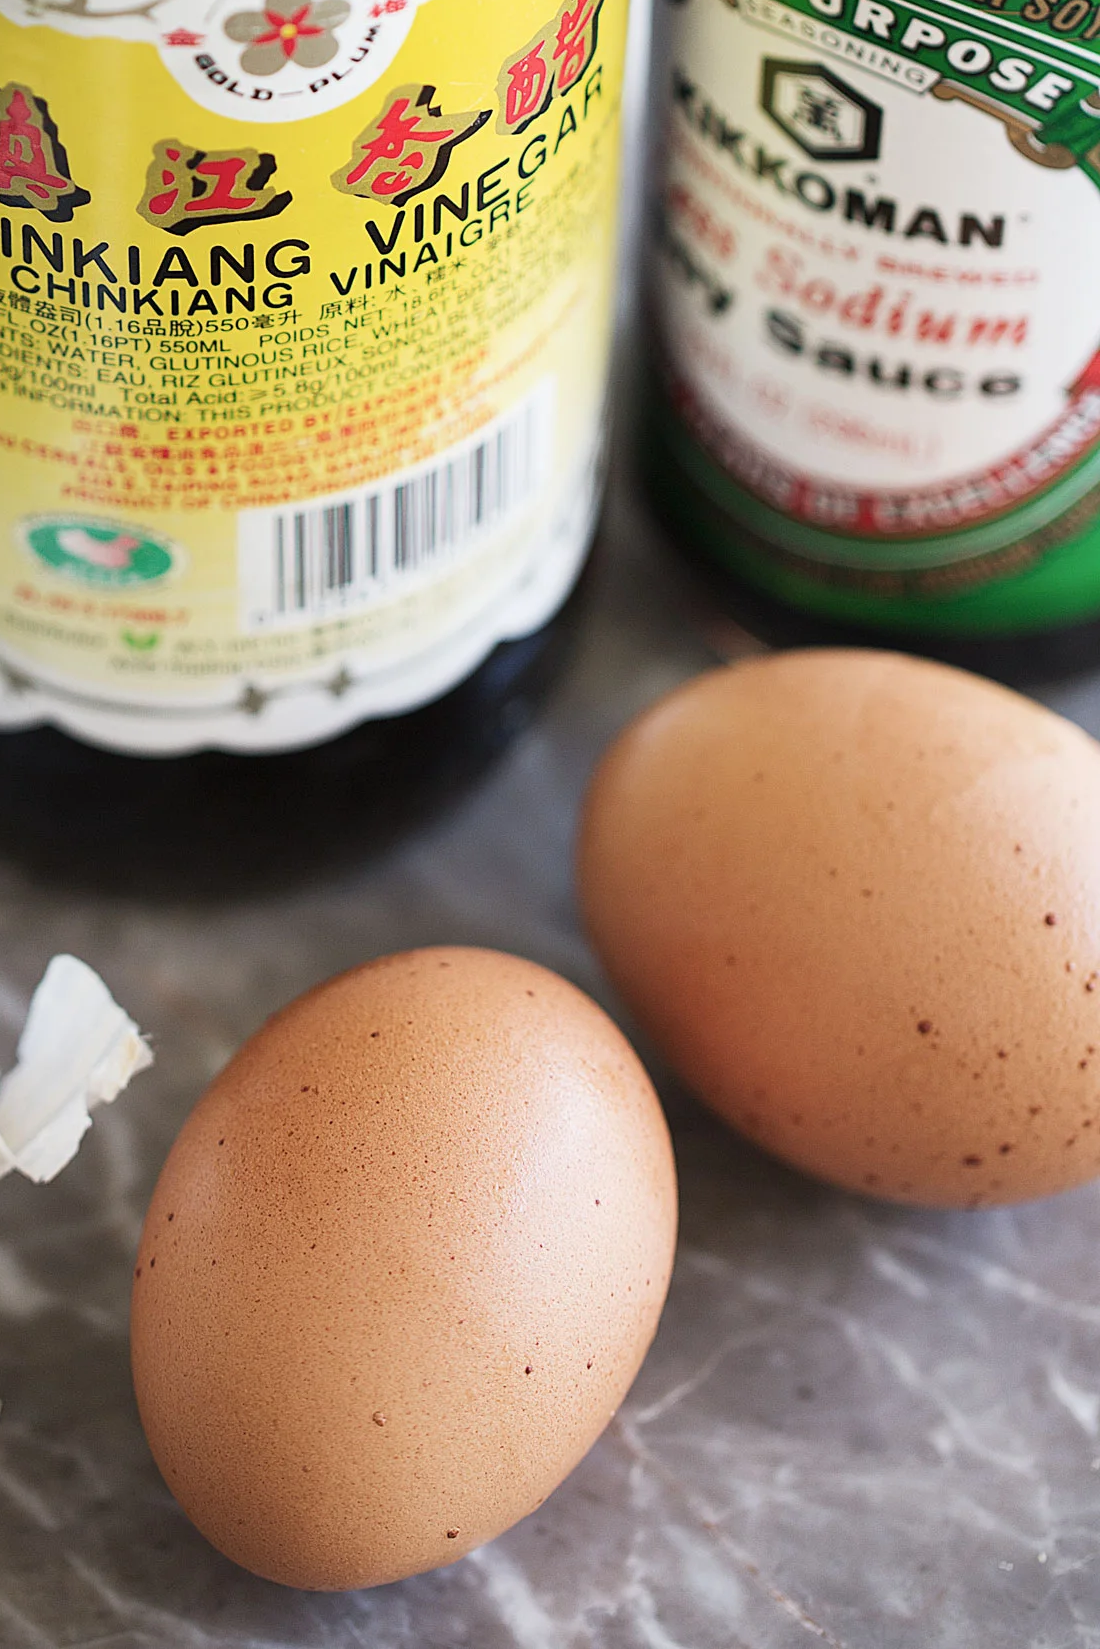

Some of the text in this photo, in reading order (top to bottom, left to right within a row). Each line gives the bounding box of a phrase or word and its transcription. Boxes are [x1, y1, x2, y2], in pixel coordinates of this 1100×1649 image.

[194, 23, 381, 101] GOLD PLUM
[365, 64, 603, 256] VINEGAR
[10, 264, 294, 317] CHINKIANG
[330, 178, 535, 296] VINAIGRE
[755, 242, 1030, 347] Sodium
[48, 341, 142, 371] WATER,
[149, 347, 294, 371] GLUTINOUS
[303, 332, 365, 359] RICE,
[372, 299, 447, 340] WHEAT
[97, 367, 153, 389] EAU,
[161, 373, 201, 389] RIZ
[208, 353, 355, 388] GLUTINEUX,
[159, 338, 232, 354] 550ML
[259, 324, 330, 348] POIDS
[763, 306, 1022, 398] Sauce
[13, 382, 188, 423] INFORMATION:
[196, 405, 252, 422] THIS
[260, 378, 378, 416] PRODUCT
[119, 387, 178, 405] Total
[166, 418, 293, 441] EXPORTED
